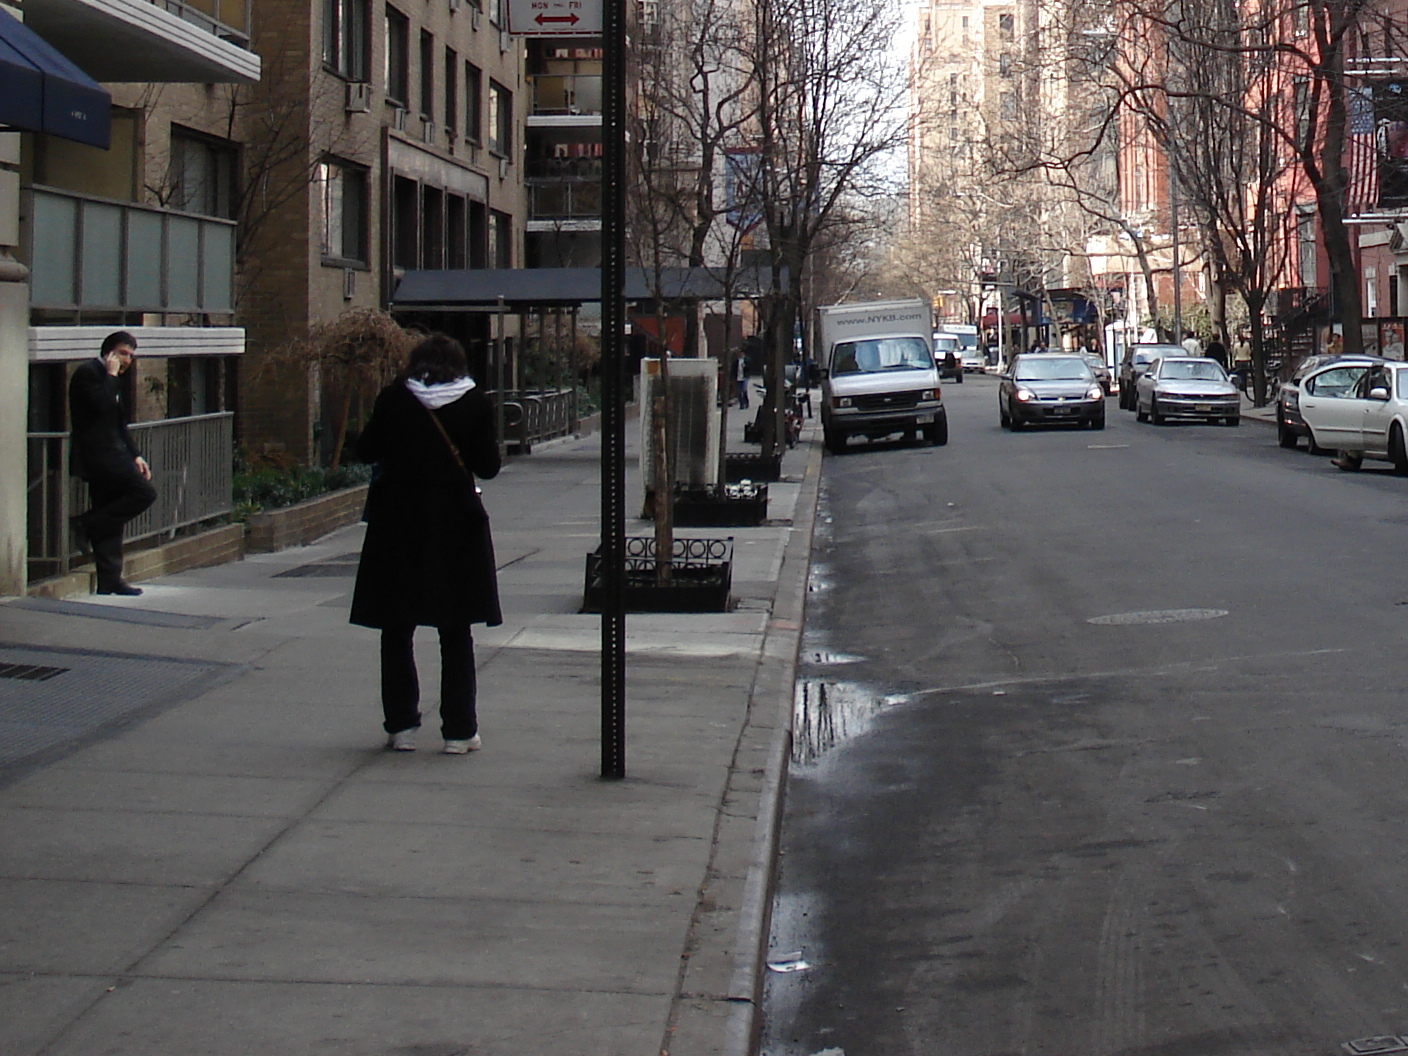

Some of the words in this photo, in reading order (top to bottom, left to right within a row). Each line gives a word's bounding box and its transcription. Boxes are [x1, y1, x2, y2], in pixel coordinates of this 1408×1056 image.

[531, 2, 548, 10] MON
[569, 1, 582, 9] FRI
[837, 313, 922, 325] www.NYKB.com
